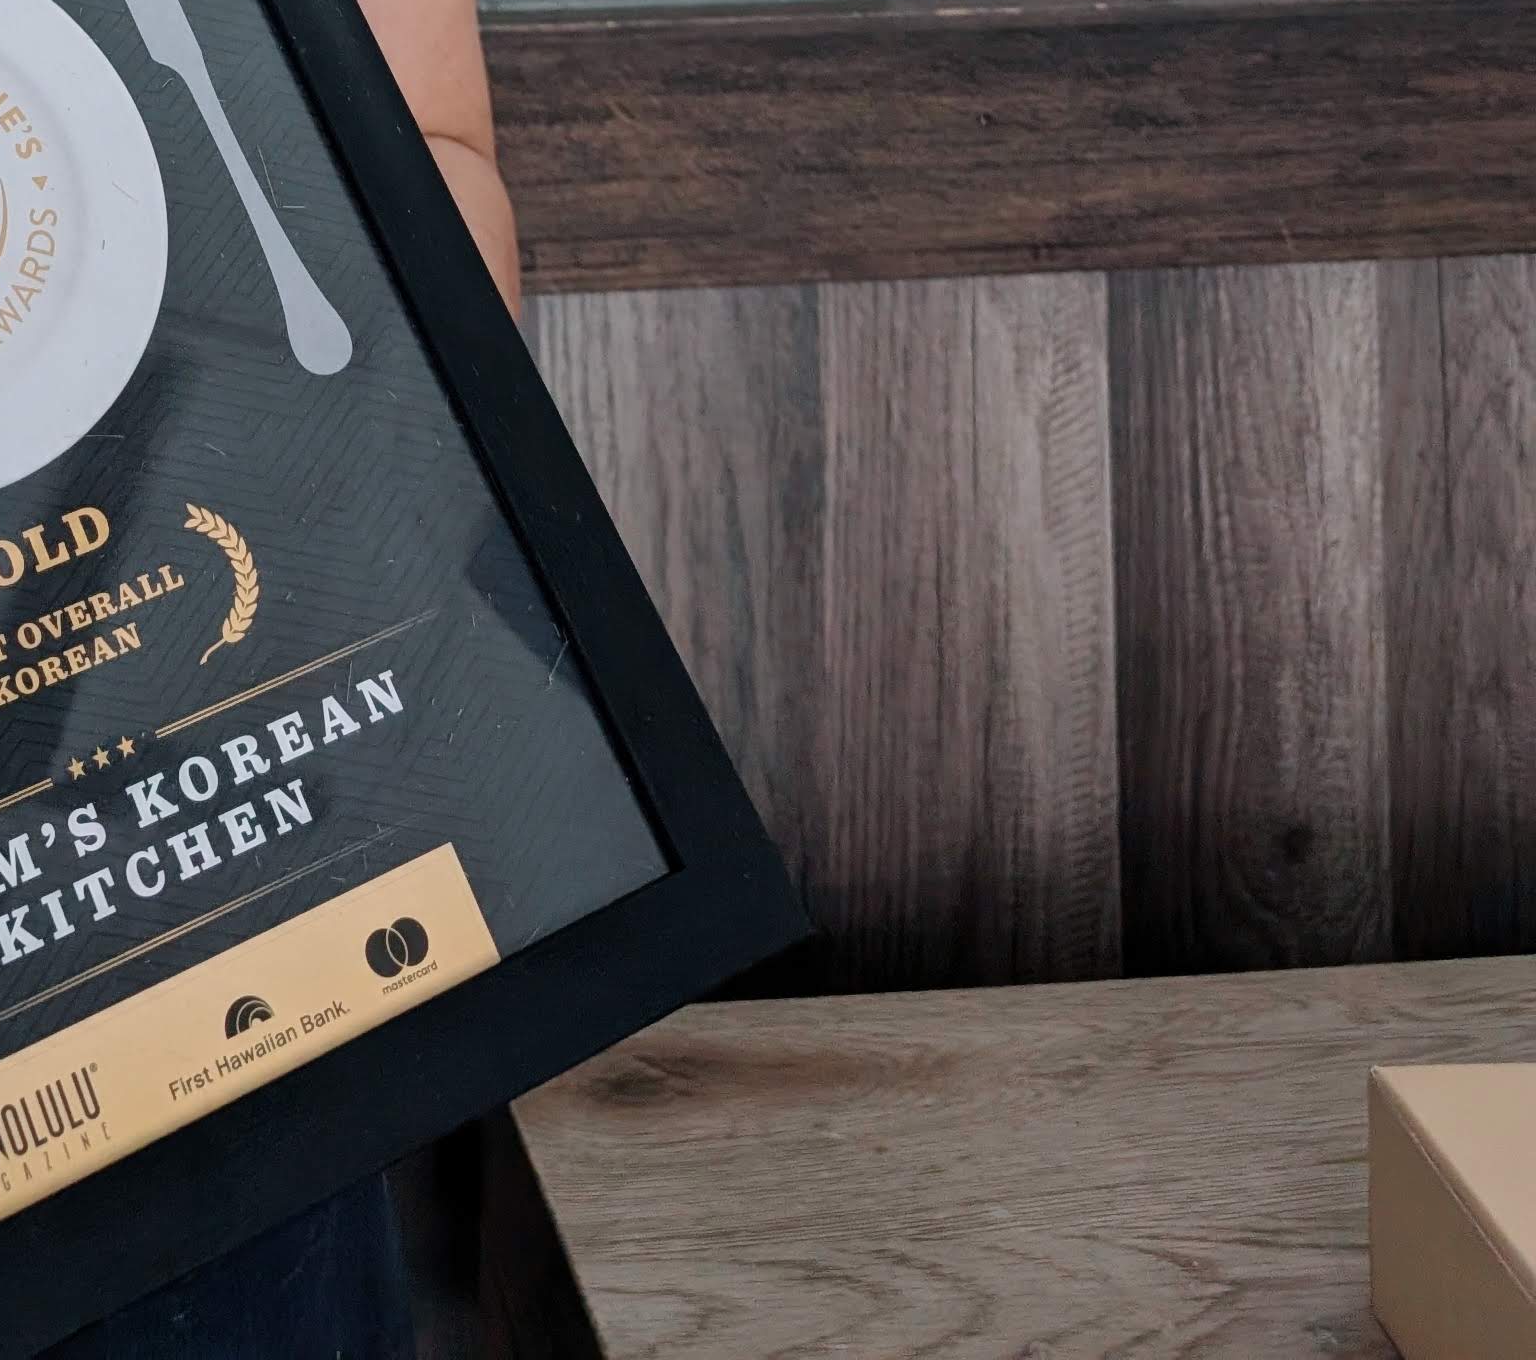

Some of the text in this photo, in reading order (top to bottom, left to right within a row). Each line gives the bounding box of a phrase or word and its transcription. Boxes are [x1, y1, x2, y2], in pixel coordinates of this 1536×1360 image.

[16, 564, 186, 650] OVERALL
[125, 669, 406, 829] KOREAN
[381, 959, 439, 997] mastercard
[168, 1065, 215, 1101] First
[215, 1026, 299, 1078] Hawaiian
